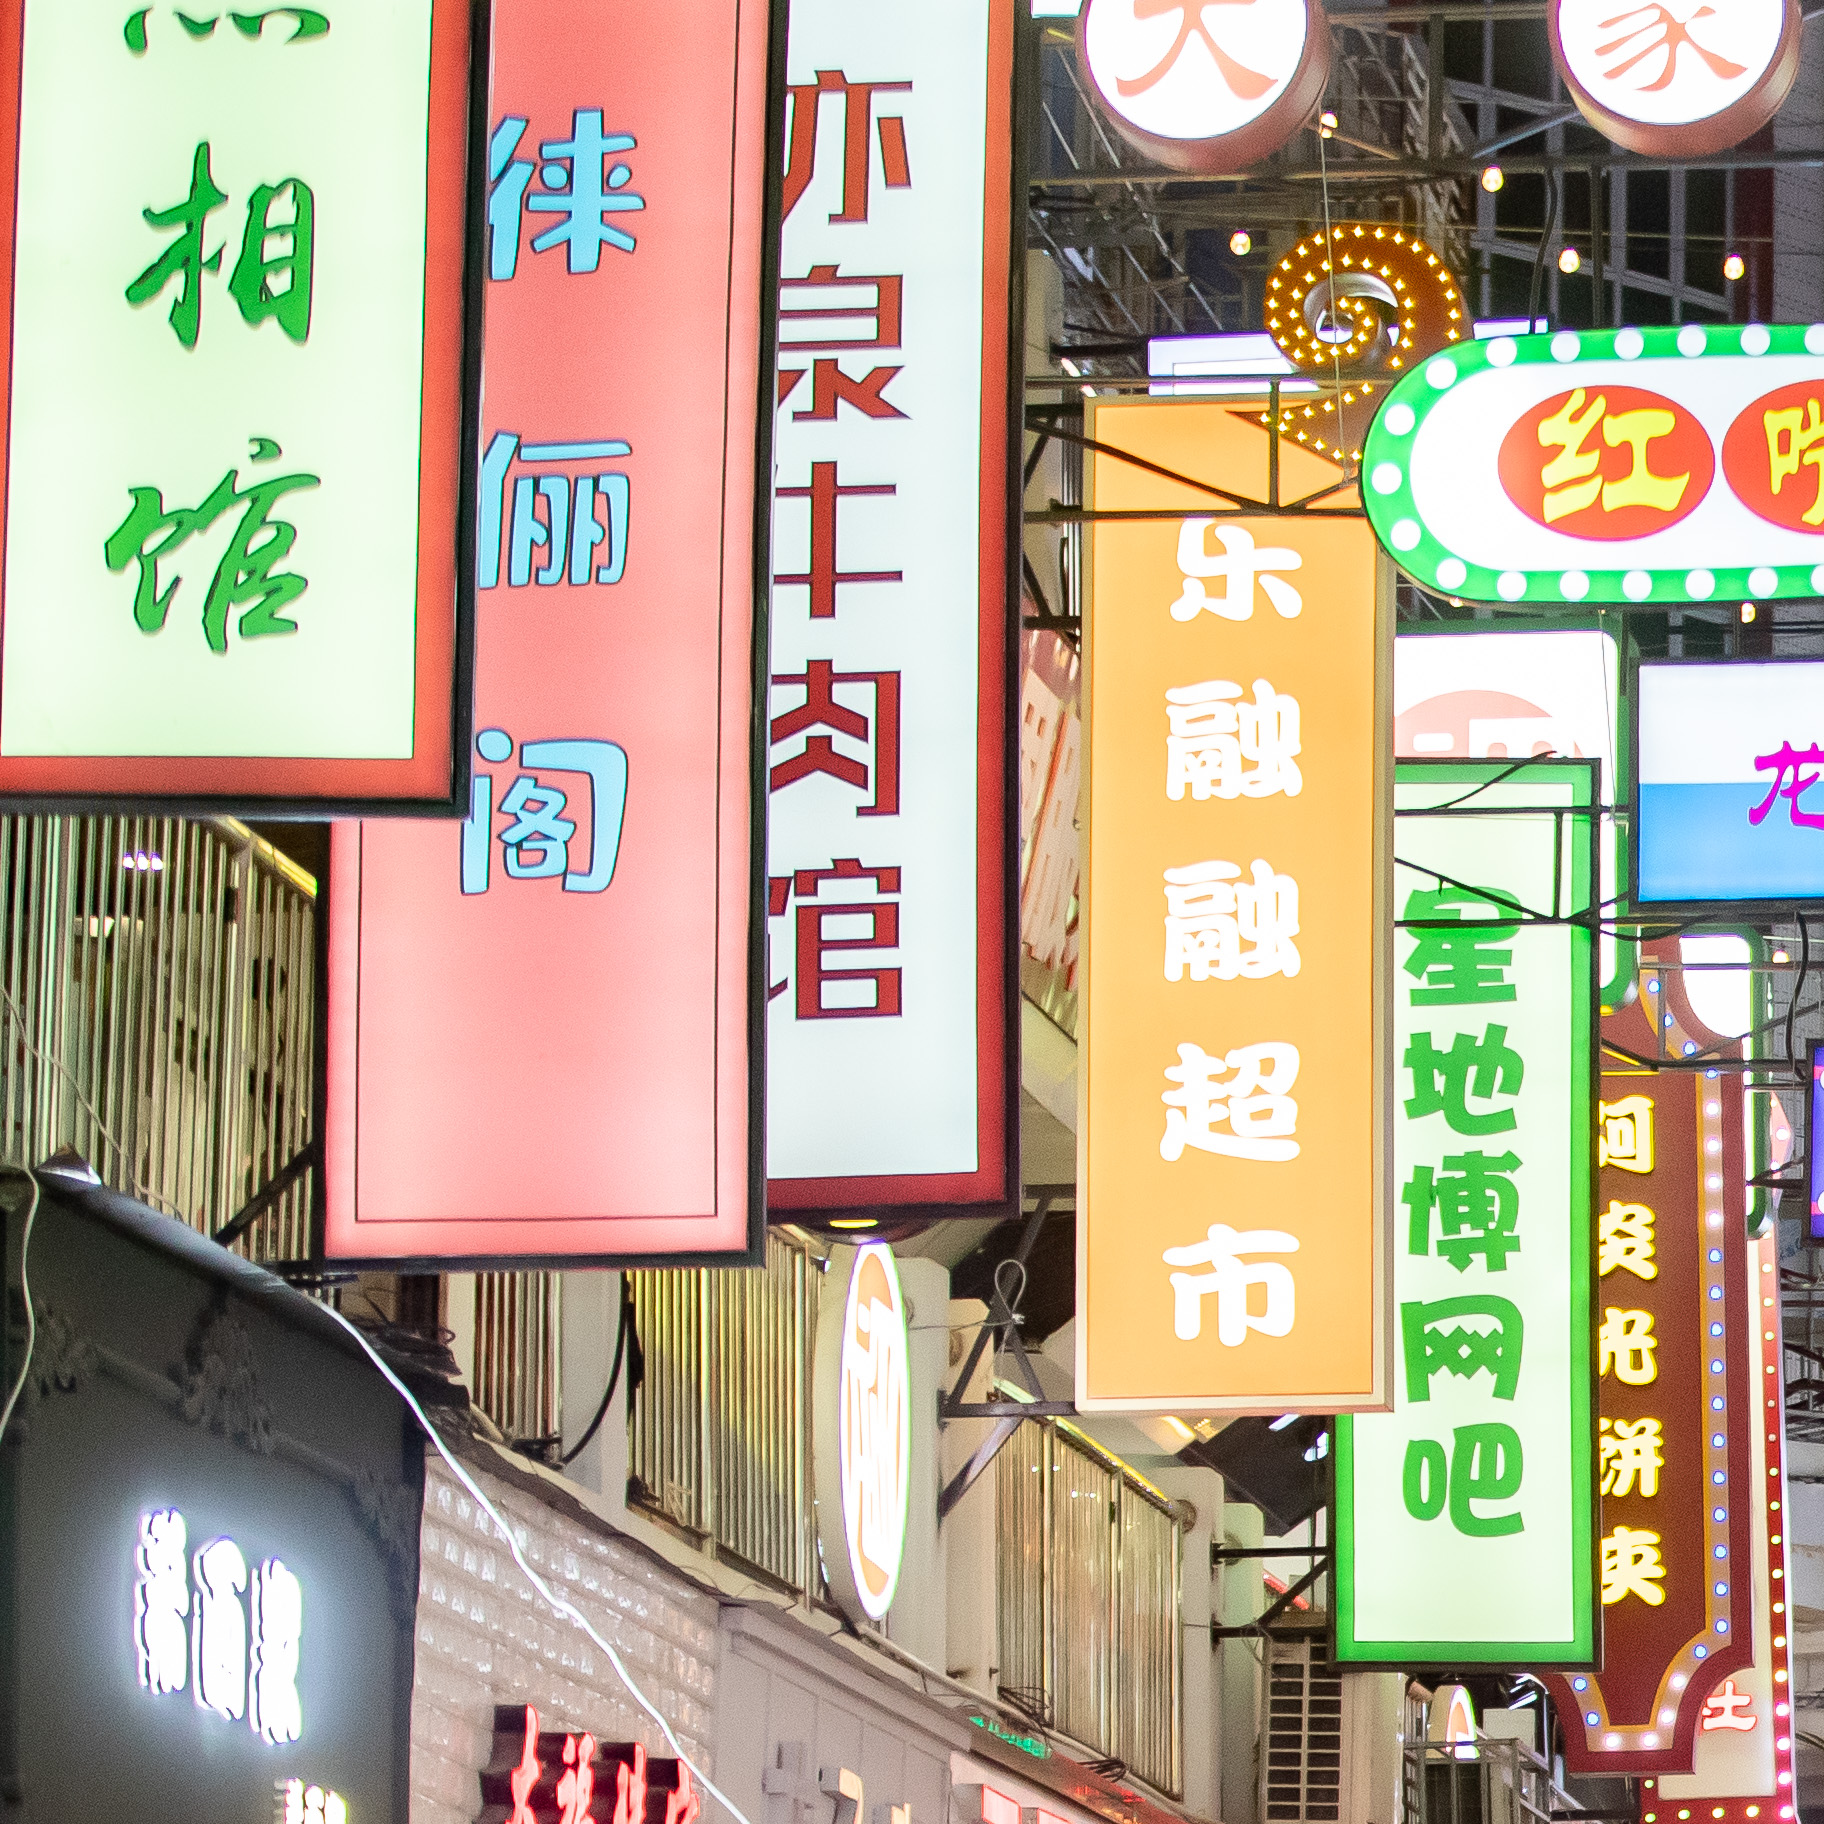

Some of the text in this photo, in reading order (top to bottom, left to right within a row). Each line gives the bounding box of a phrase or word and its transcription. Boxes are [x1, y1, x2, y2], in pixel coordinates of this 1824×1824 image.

[104, 7, 331, 654] 相馆
[460, 108, 646, 895] 徕俪阁
[1159, 516, 1303, 1346] 乐融融超市
[1402, 886, 1525, 1537] 星地博网吧
